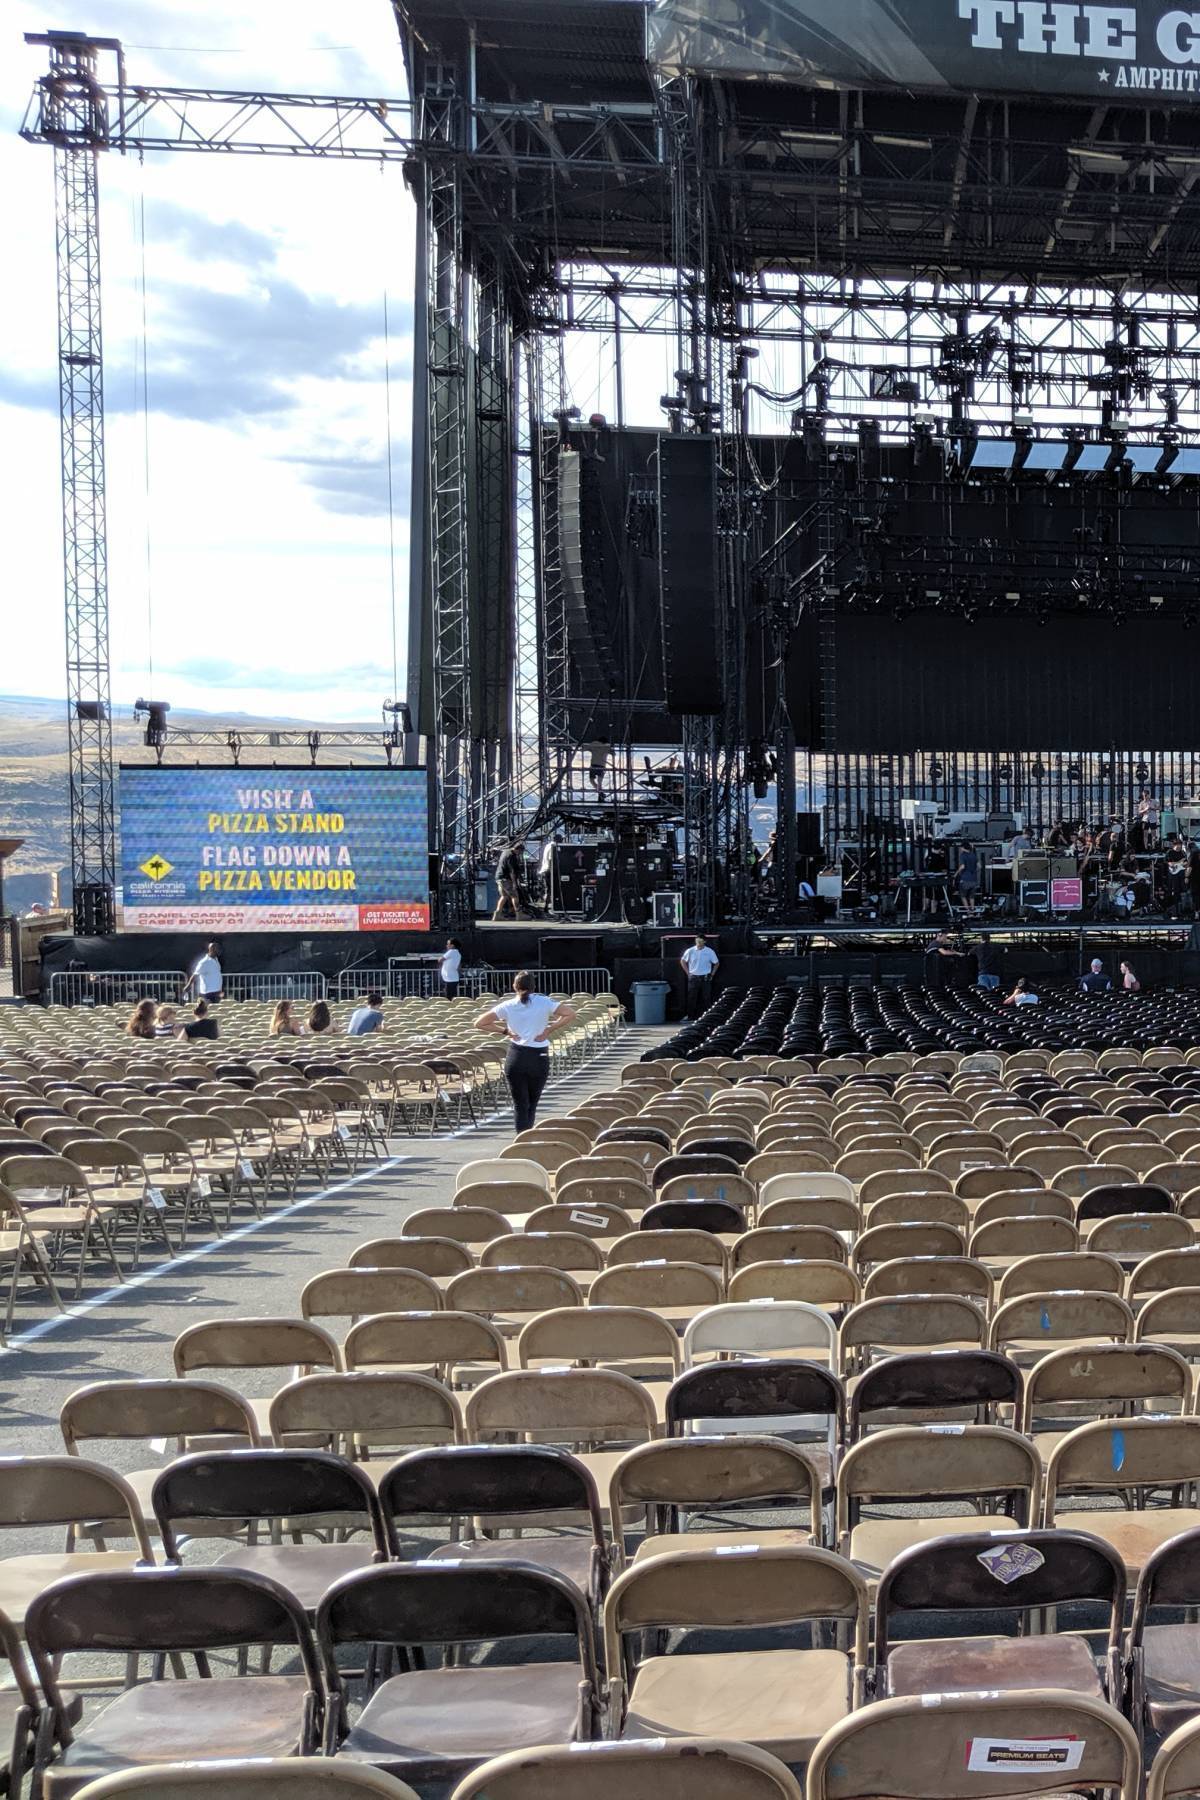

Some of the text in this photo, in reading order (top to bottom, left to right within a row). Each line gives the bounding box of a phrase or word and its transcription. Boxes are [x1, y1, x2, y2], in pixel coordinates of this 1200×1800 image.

[958, 0, 1137, 60] THE
[238, 789, 314, 809] VISIT A
[208, 813, 345, 833] PIZZA STAND
[202, 846, 352, 866] FLAG DOWN A
[198, 870, 357, 891] PIZZA VENDOR
[990, 1751, 1034, 1759] PREMIUM
